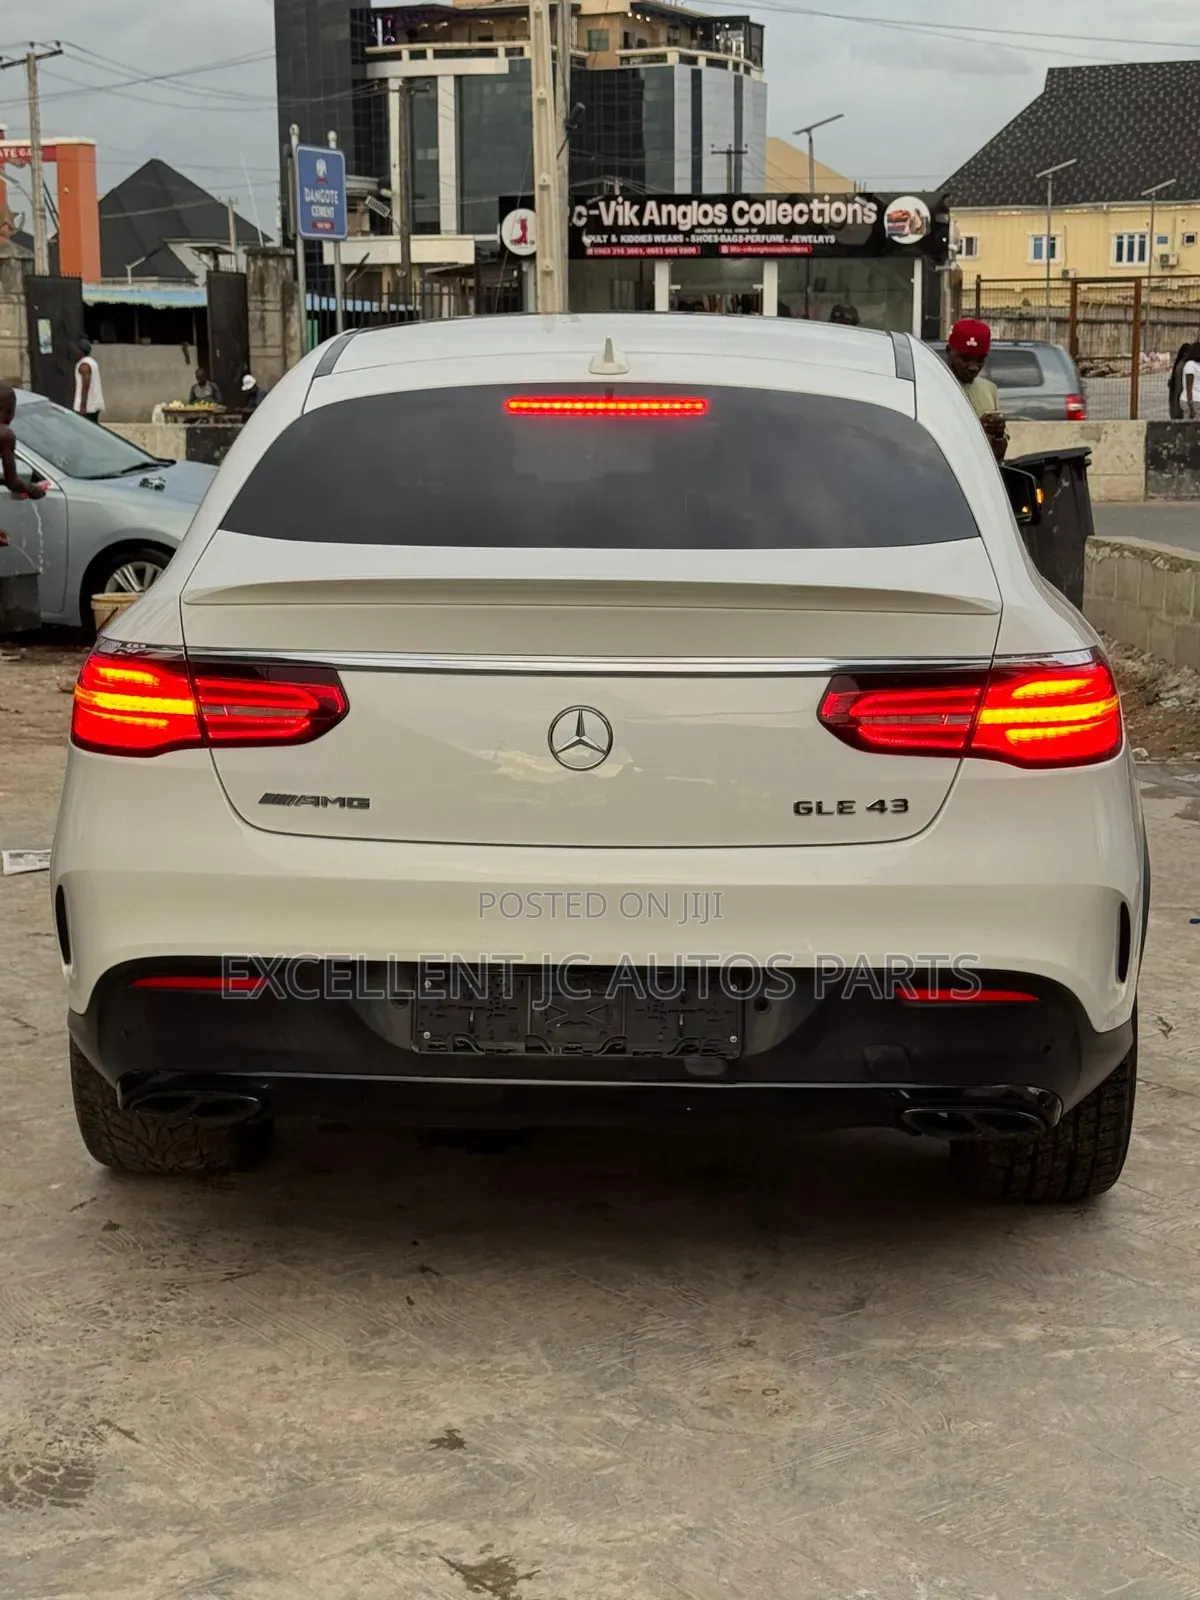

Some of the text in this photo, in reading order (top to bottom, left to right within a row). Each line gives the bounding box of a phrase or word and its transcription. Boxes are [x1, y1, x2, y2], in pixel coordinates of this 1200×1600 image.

[303, 187, 339, 205] DANGOTE
[642, 200, 728, 231] Anglos
[731, 195, 878, 227] Collections
[619, 234, 653, 243] KIDDIES
[654, 234, 684, 243] WEARS
[790, 234, 836, 244] JEWELRYS
[793, 798, 909, 816] GLE 43
